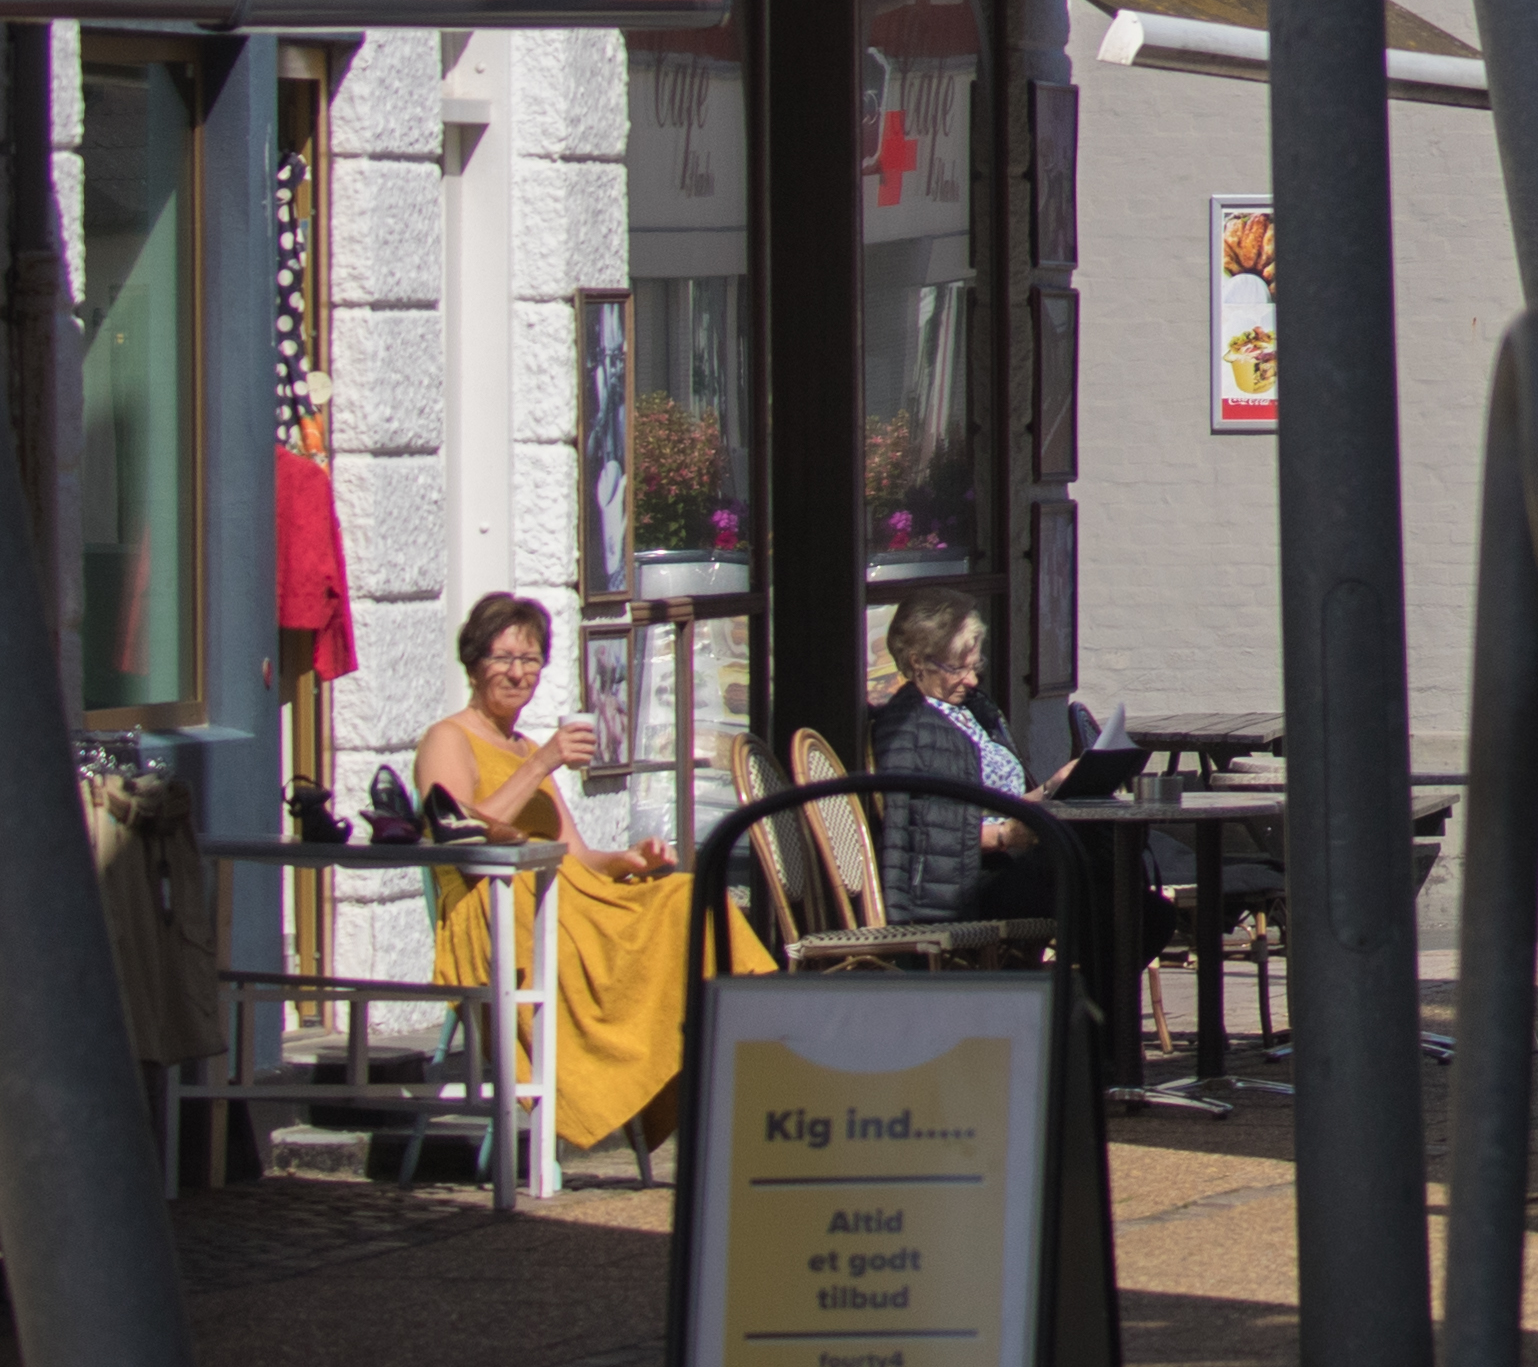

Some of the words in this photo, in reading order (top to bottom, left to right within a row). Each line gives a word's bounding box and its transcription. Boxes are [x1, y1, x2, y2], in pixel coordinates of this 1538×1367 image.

[766, 1108, 832, 1149] Kig
[827, 1208, 904, 1235] Altid
[808, 1251, 840, 1272] et
[848, 1247, 922, 1278] godt
[816, 1285, 910, 1310] tilbud
